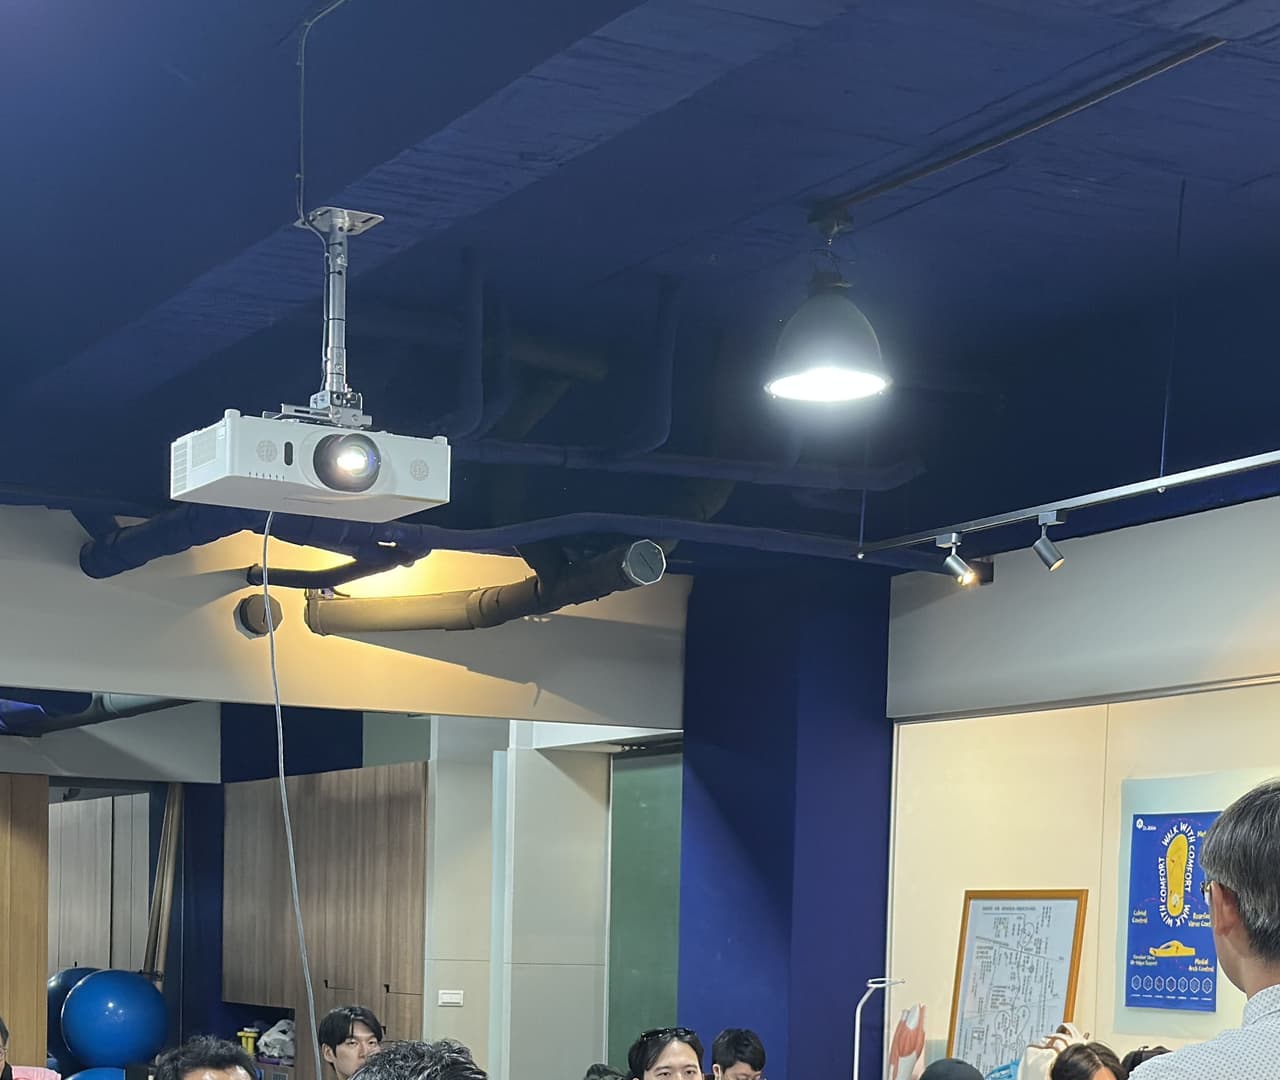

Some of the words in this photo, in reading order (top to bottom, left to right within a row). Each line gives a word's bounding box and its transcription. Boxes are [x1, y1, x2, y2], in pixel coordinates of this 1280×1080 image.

[1161, 825, 1179, 847] WALK
[1180, 822, 1196, 843] WITH
[1158, 857, 1167, 903] COMFORT
[1184, 845, 1195, 893] COMFORT
[1159, 905, 1173, 928] WITH
[1176, 904, 1191, 928] WALK
